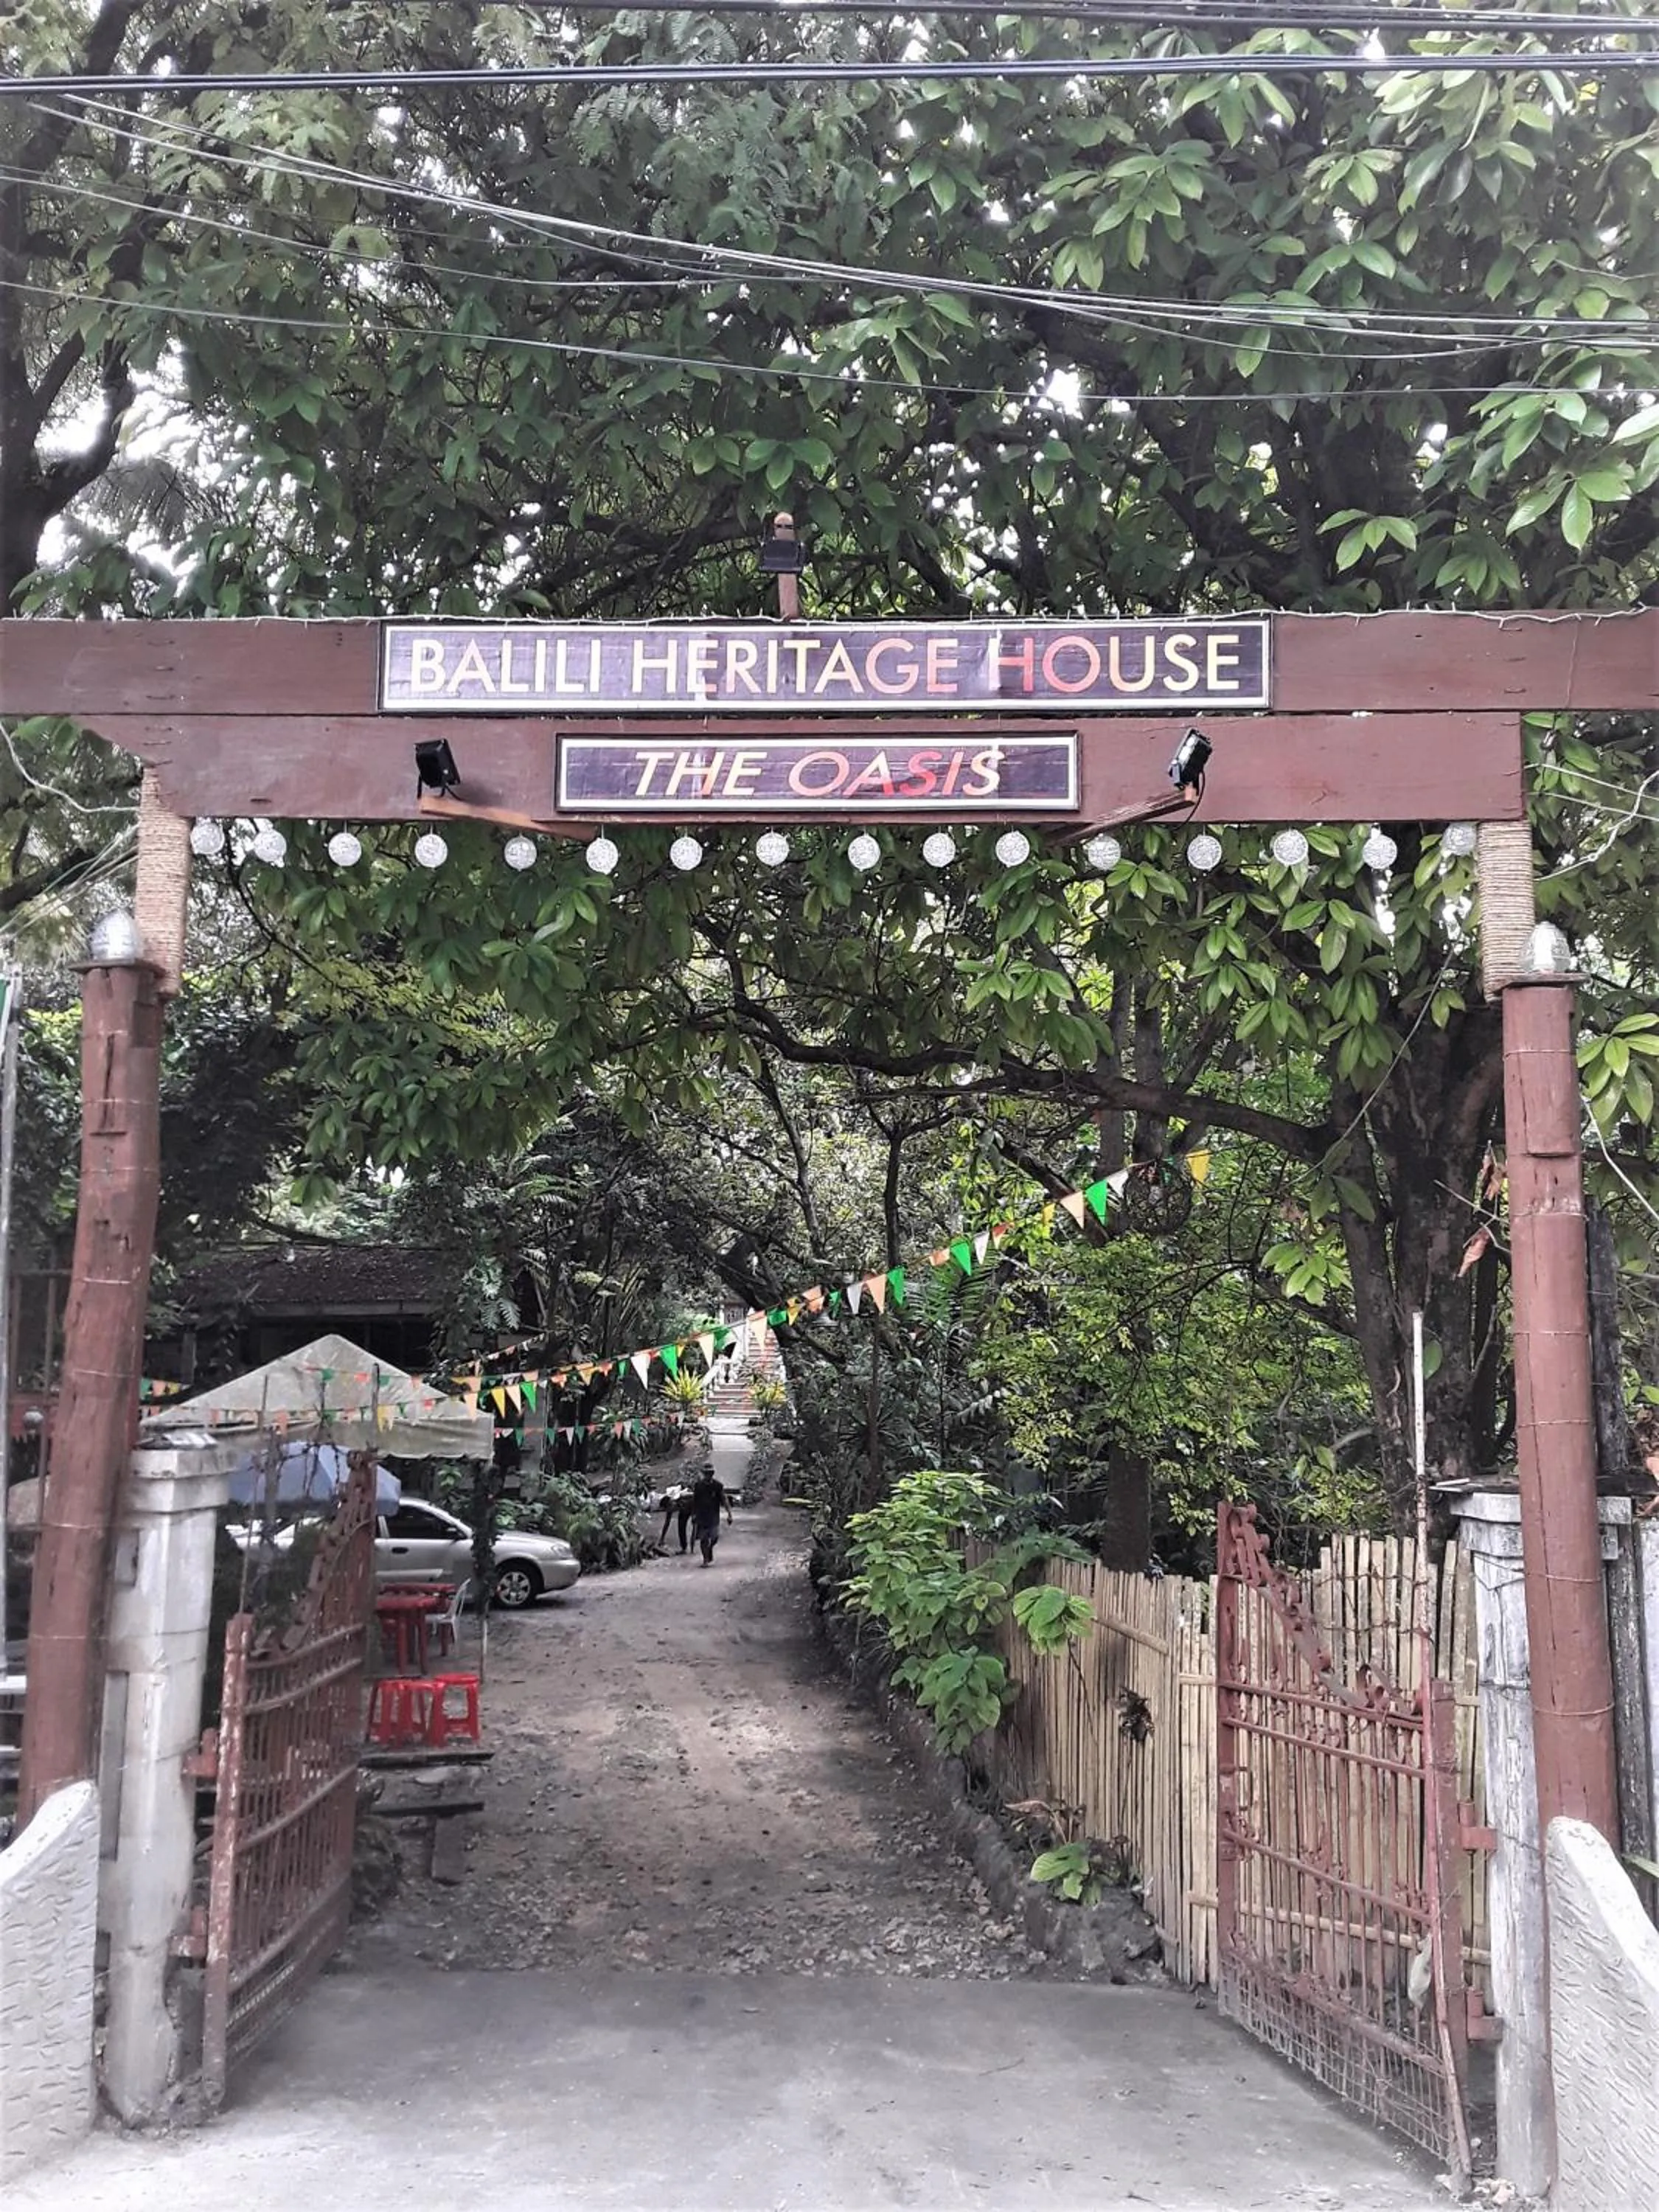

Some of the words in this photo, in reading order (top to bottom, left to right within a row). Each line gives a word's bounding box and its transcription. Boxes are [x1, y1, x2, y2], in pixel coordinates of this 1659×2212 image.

[410, 639, 600, 695] BALILI
[631, 637, 959, 695] HERITAGE
[989, 633, 1240, 693] HOUSE
[635, 751, 768, 796] THE
[787, 748, 1006, 797] OASIS
